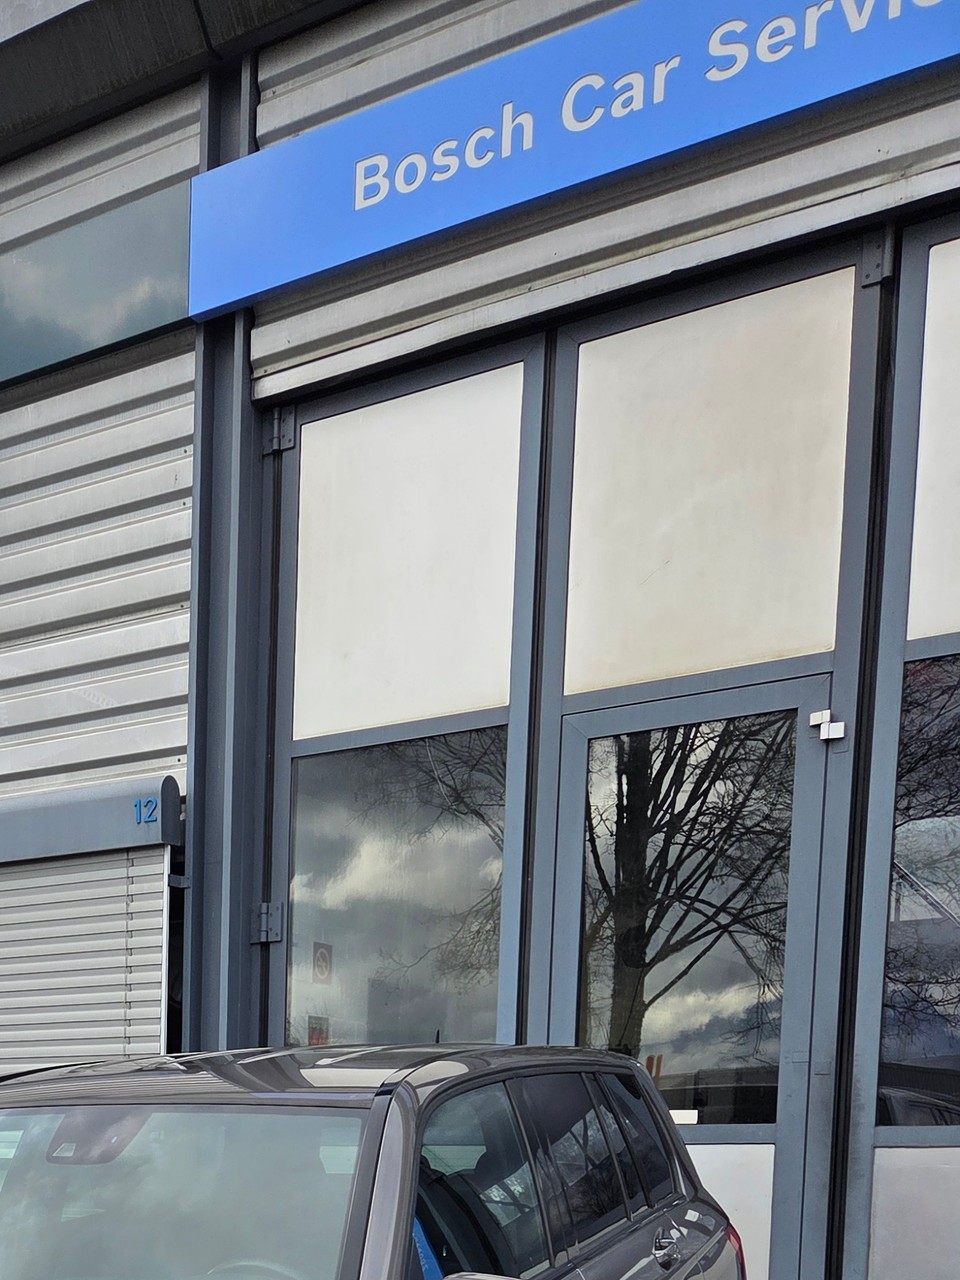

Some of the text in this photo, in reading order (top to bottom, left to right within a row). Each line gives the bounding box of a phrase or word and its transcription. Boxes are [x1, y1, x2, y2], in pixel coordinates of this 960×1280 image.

[354, 0, 942, 211] Bosch Car Serv
[134, 797, 158, 825] 12
